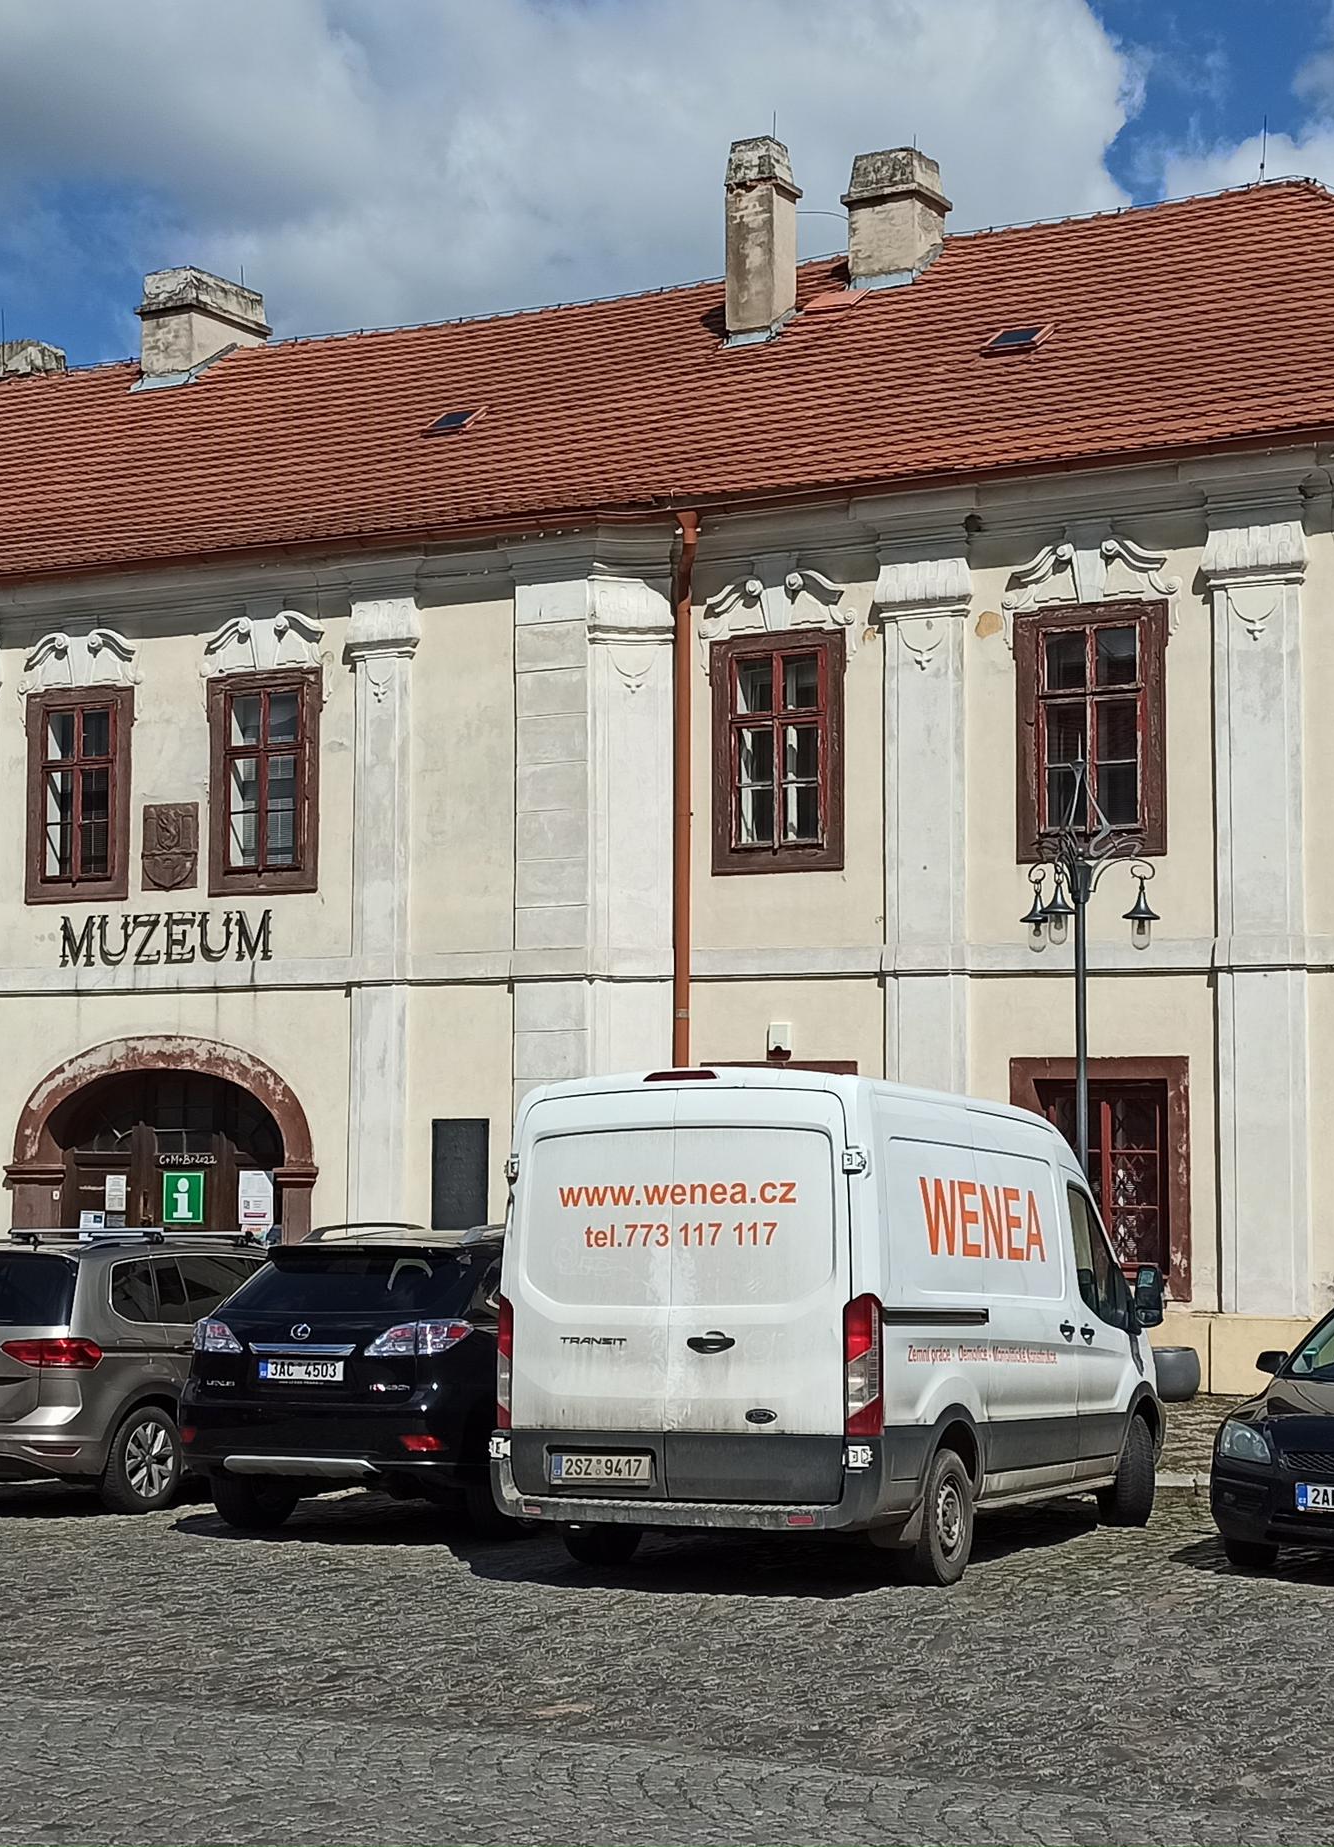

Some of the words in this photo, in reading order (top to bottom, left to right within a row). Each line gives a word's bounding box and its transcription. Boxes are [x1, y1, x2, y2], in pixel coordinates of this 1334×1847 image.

[58, 909, 273, 968] MUZEUM
[558, 1181, 797, 1208] www.wenea.cz
[918, 1176, 1047, 1263] WENEA
[584, 1223, 670, 1248] tel.773
[678, 1222, 723, 1247] 117
[732, 1221, 778, 1246] 117
[560, 1336, 627, 1346] TRANSIT
[270, 1361, 294, 1377] 3AC
[304, 1362, 337, 1379] 4503
[564, 1458, 593, 1477] 2SZ
[604, 1458, 643, 1477] 9417
